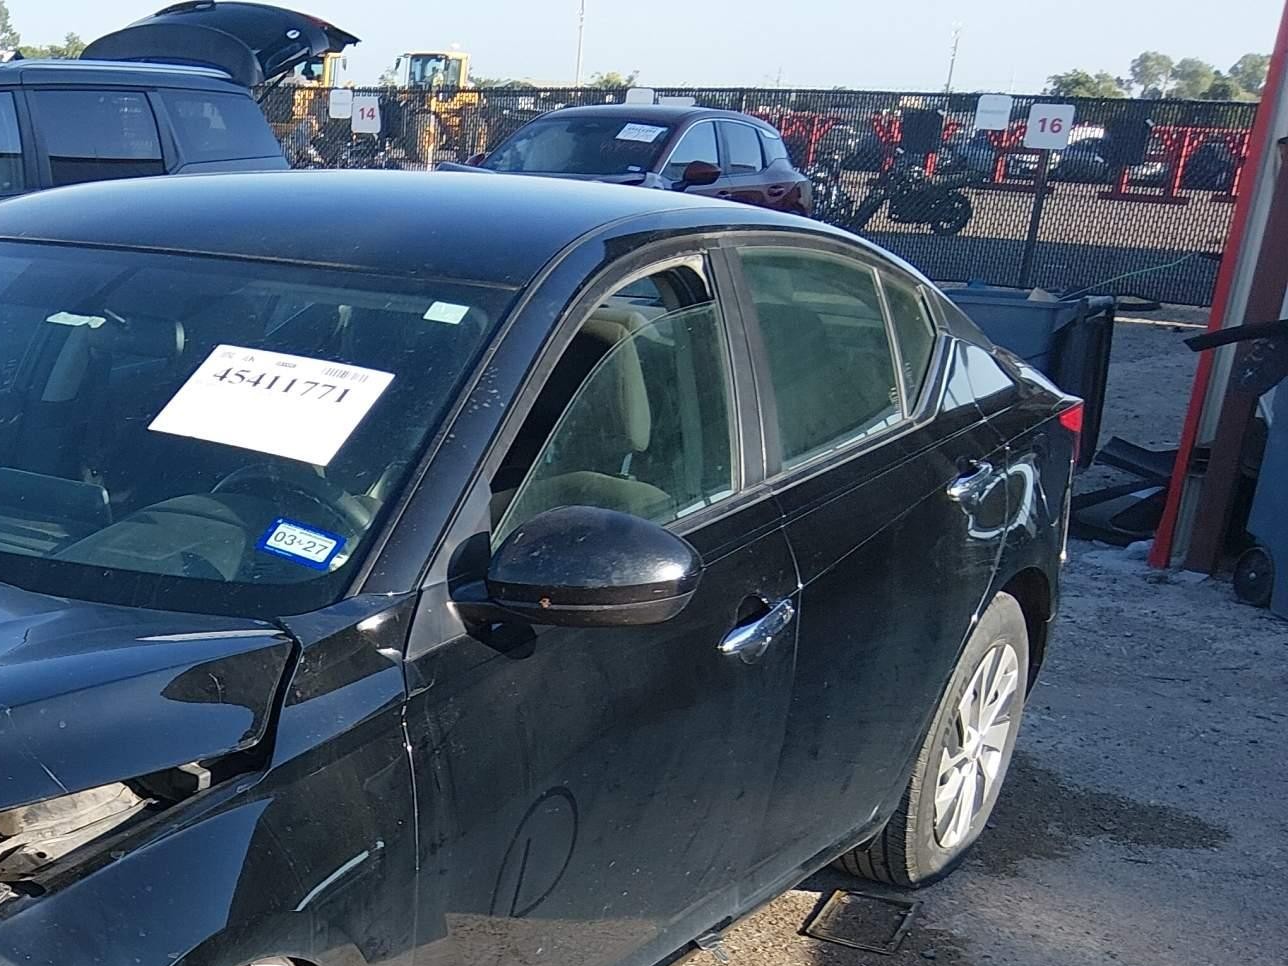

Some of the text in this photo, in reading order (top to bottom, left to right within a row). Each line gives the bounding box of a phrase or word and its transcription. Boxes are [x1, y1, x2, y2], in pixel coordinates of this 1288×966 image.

[358, 107, 376, 121] 14
[1038, 117, 1063, 133] 16
[212, 367, 351, 404] 45411771
[273, 531, 297, 546] 03
[301, 540, 329, 555] 27
